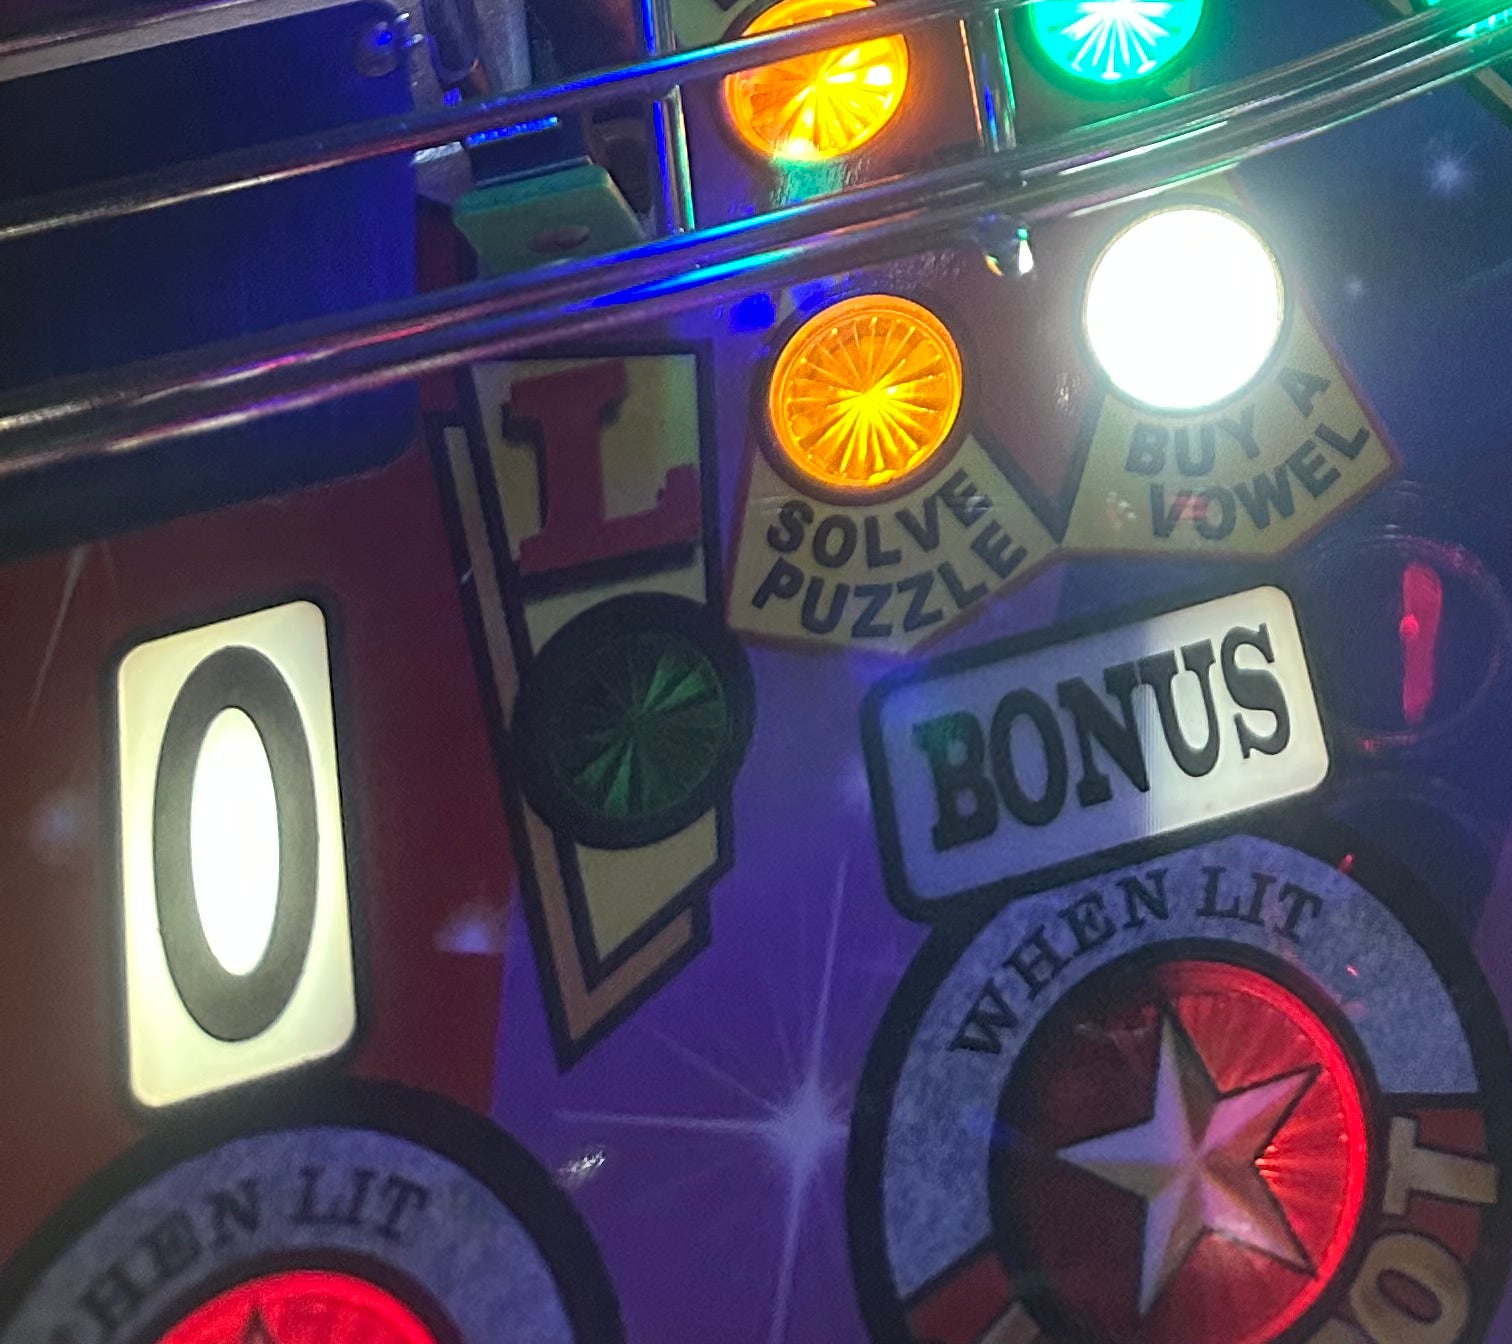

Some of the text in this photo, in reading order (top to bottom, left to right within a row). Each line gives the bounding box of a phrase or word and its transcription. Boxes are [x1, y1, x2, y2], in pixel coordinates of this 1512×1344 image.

[505, 359, 699, 578] L
[1123, 366, 1332, 476] BUY A
[1148, 418, 1370, 542] VOWEL
[751, 518, 1028, 639] PUZZLE
[766, 469, 996, 569] SOLVE
[911, 623, 1291, 853] BONUS
[952, 861, 1327, 1061] WHEN LIT
[291, 1163, 434, 1240] LIT
